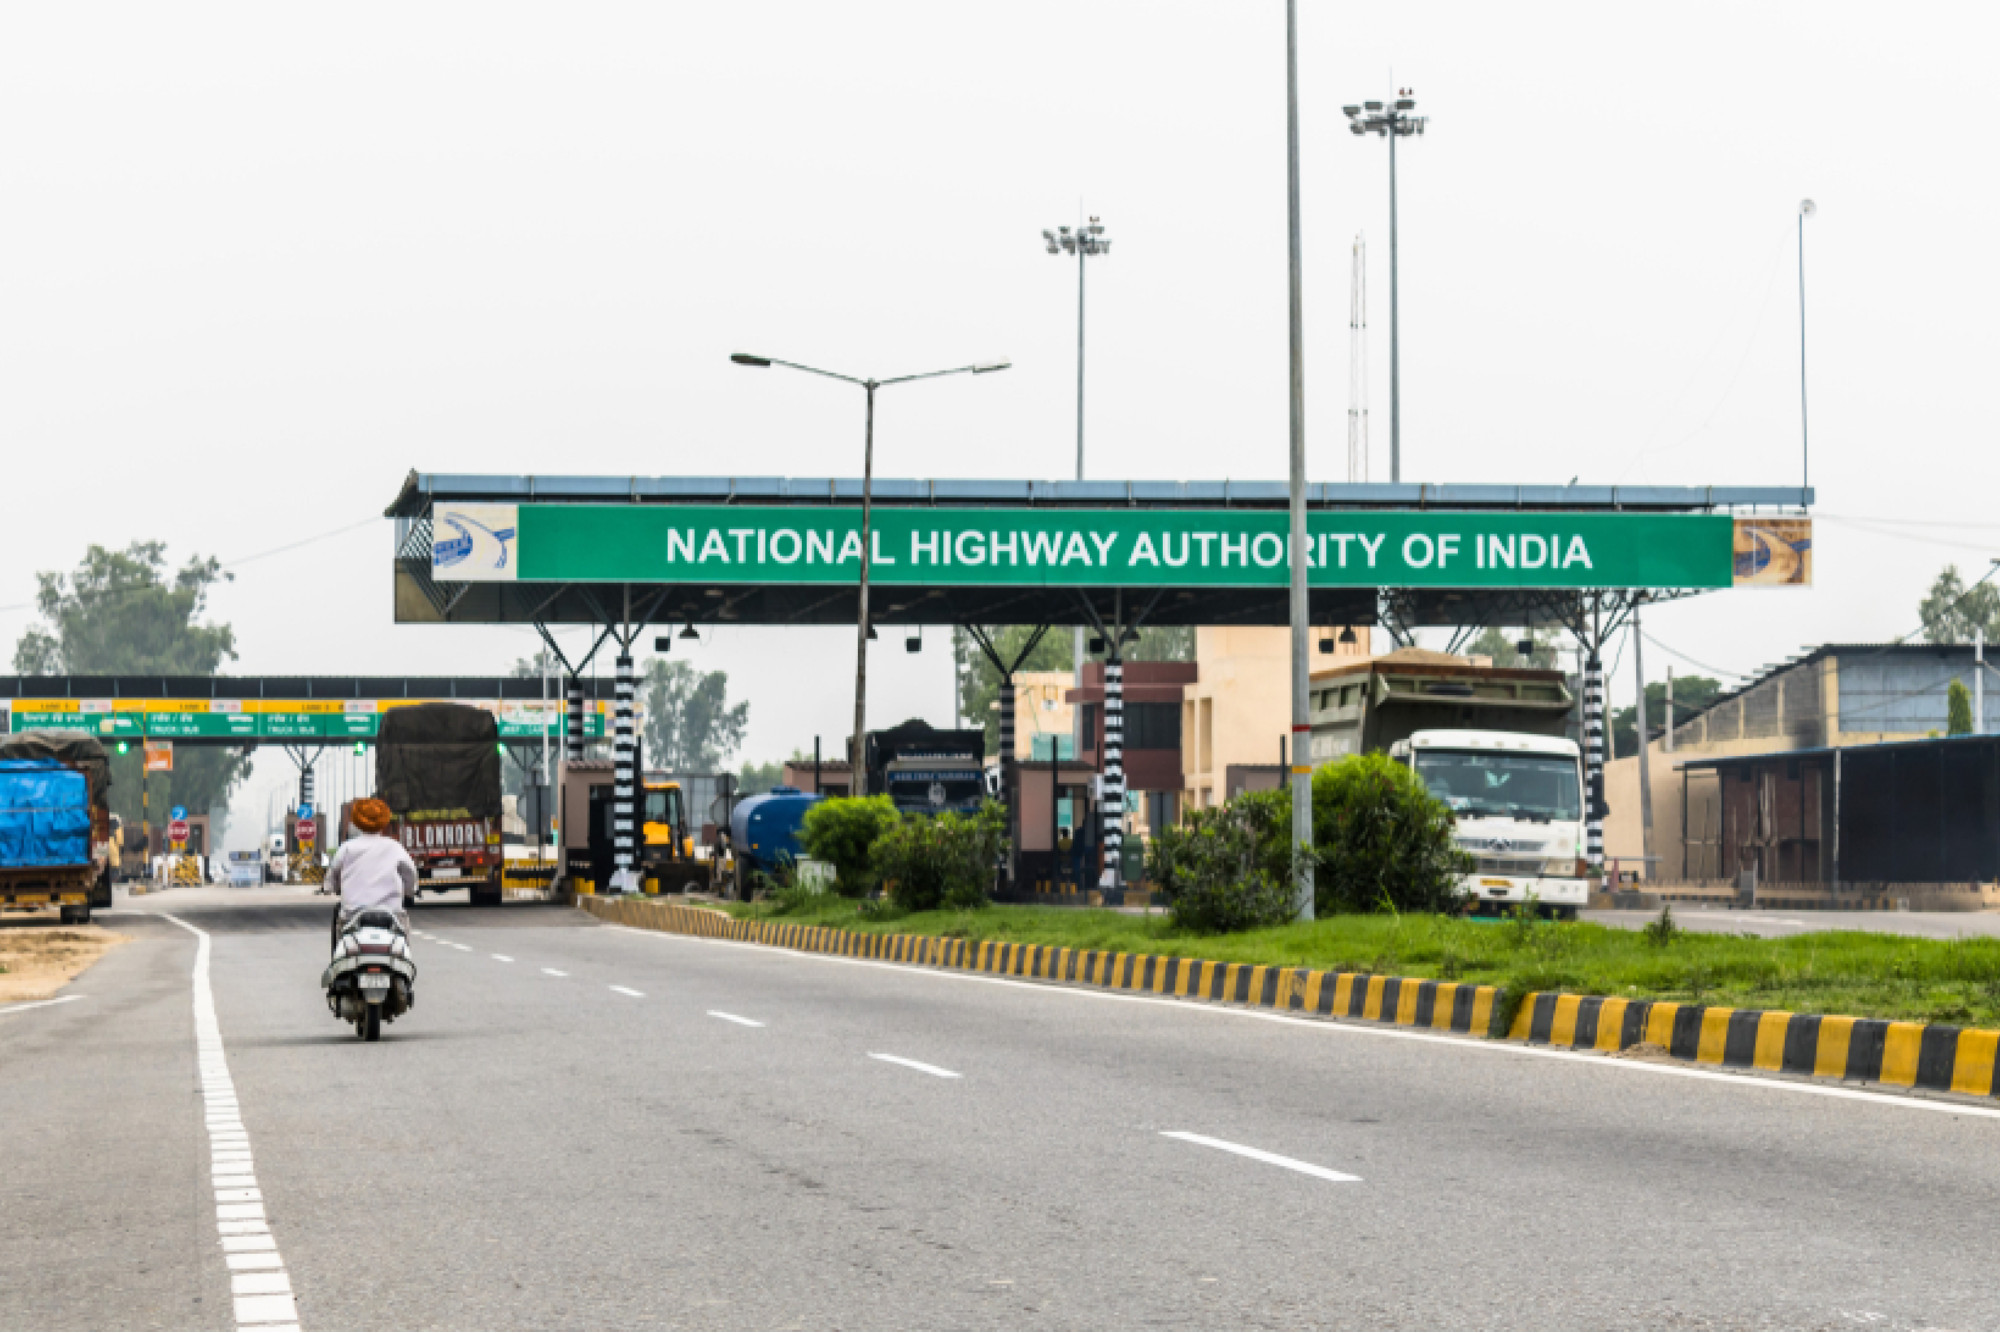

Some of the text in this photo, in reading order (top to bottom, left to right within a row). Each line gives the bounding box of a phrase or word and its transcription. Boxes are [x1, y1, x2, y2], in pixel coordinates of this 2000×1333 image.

[667, 528, 1594, 569] NATIONAL HIGHWAY AUTHORITY OF INDIA
